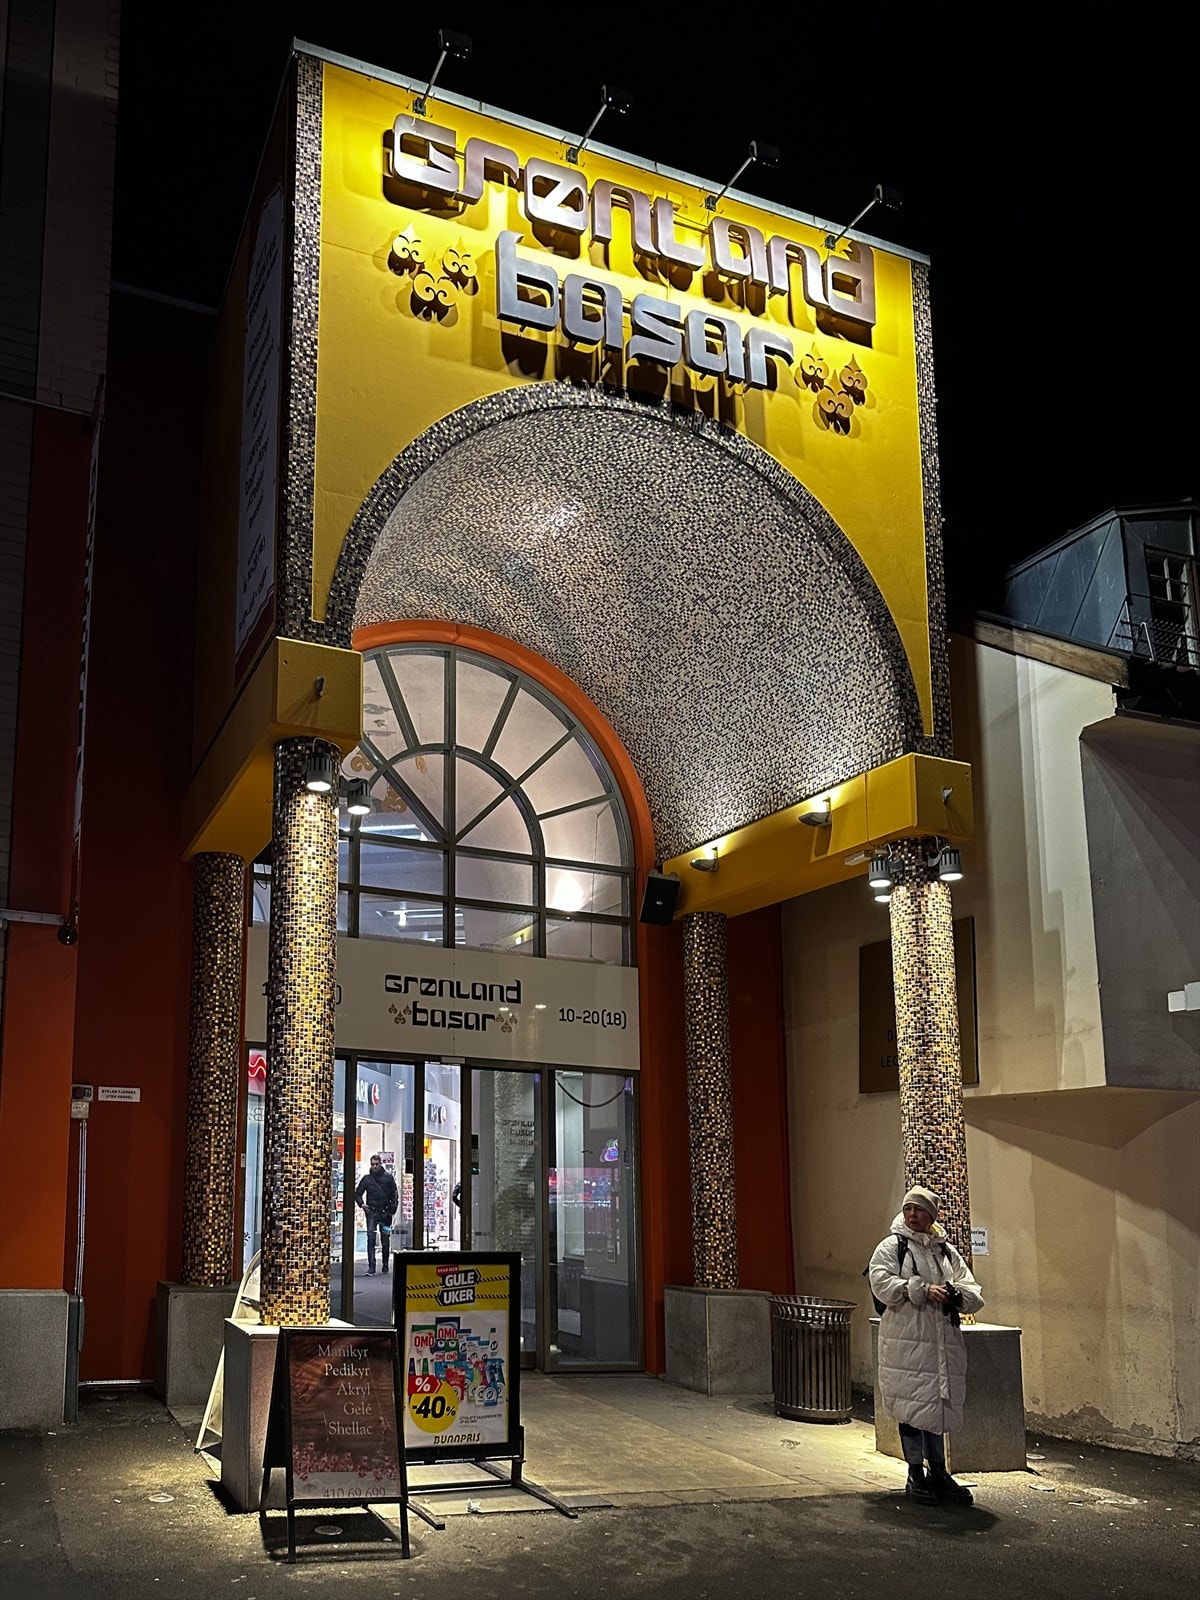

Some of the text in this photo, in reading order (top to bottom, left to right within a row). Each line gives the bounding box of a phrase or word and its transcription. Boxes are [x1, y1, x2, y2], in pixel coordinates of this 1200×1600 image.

[496, 230, 794, 390] basar
[412, 1000, 496, 1031] basar
[558, 1007, 627, 1030] 10-20(18)
[444, 1271, 475, 1287] GULE
[443, 1288, 474, 1305] UKER
[414, 1335, 435, 1347] OMO
[438, 1327, 458, 1339] OMO
[317, 1344, 369, 1359] Manikyr
[324, 1363, 370, 1379] Pedikyr
[337, 1383, 371, 1399] Akryl
[343, 1402, 372, 1416] Gelé
[328, 1421, 373, 1436] Shellac
